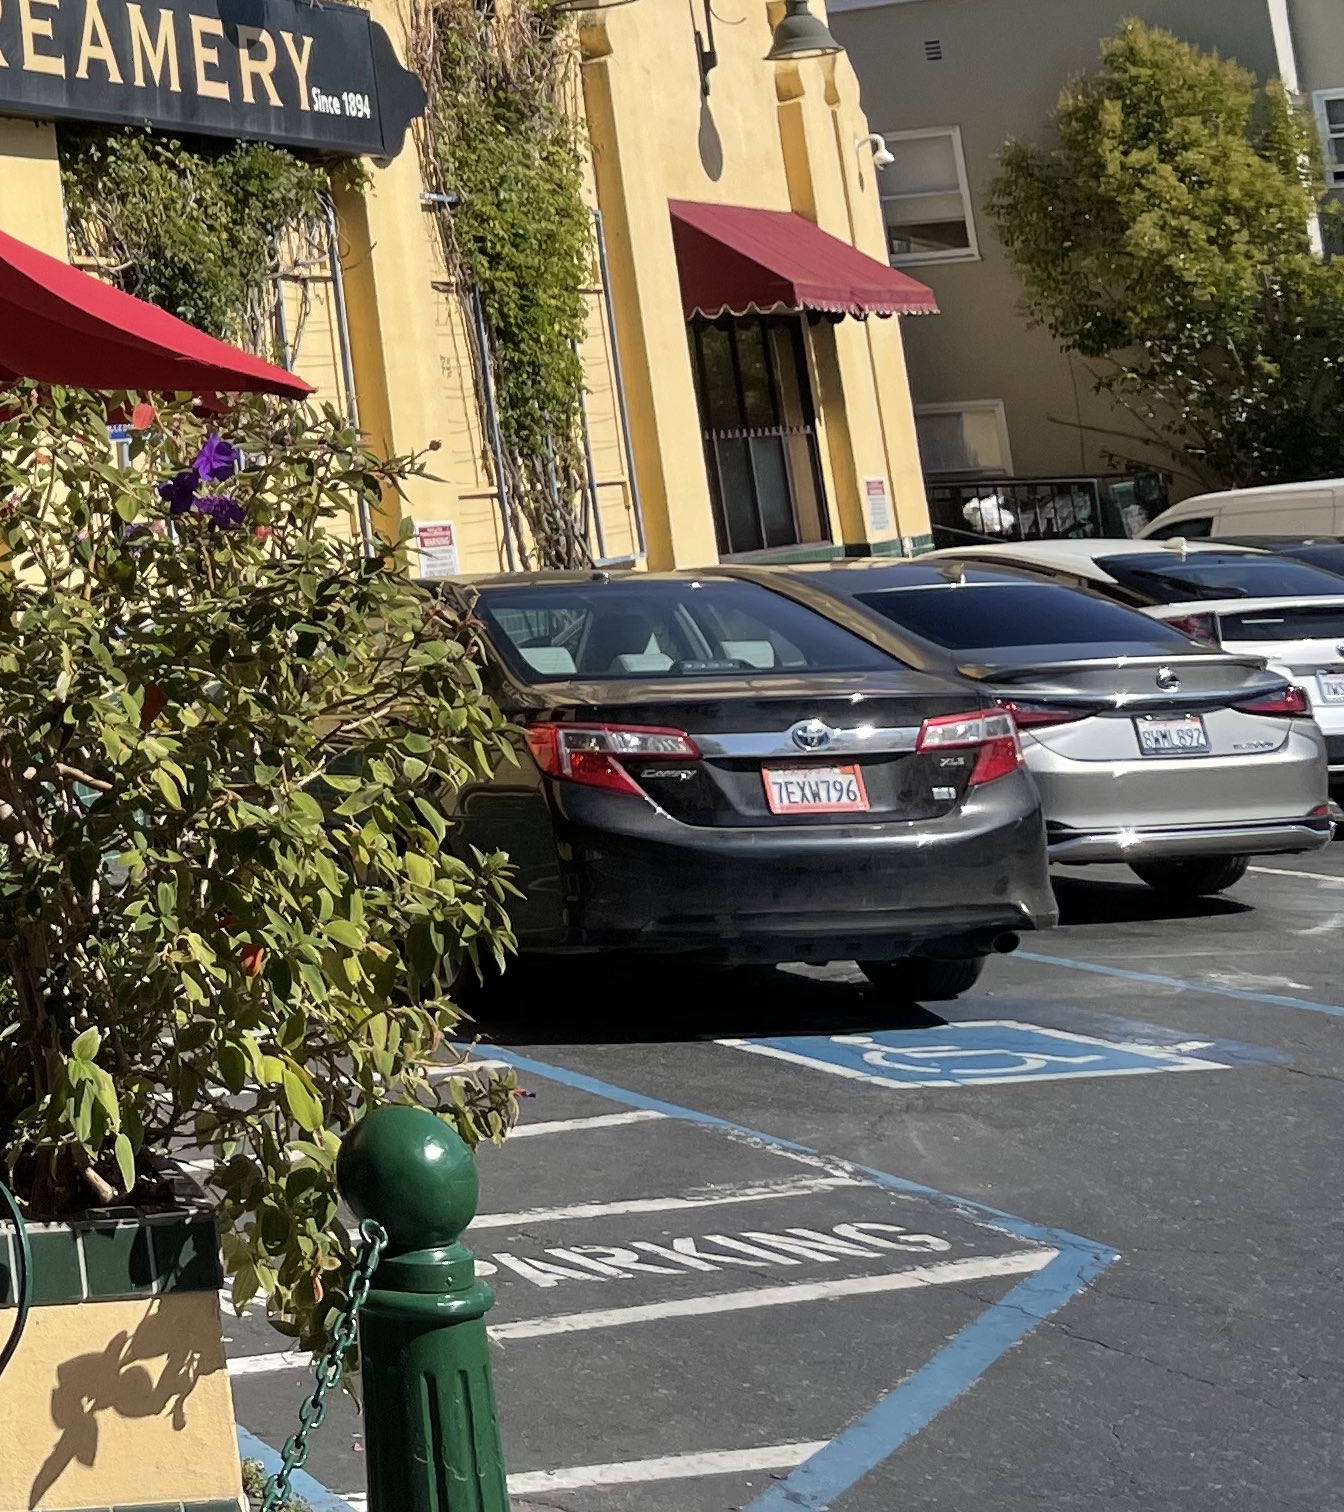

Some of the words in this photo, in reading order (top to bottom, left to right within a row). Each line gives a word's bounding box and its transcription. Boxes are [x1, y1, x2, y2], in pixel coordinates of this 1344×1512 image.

[311, 86, 341, 115] Since
[342, 91, 371, 119] 1894
[772, 779, 858, 805] 7EXW796
